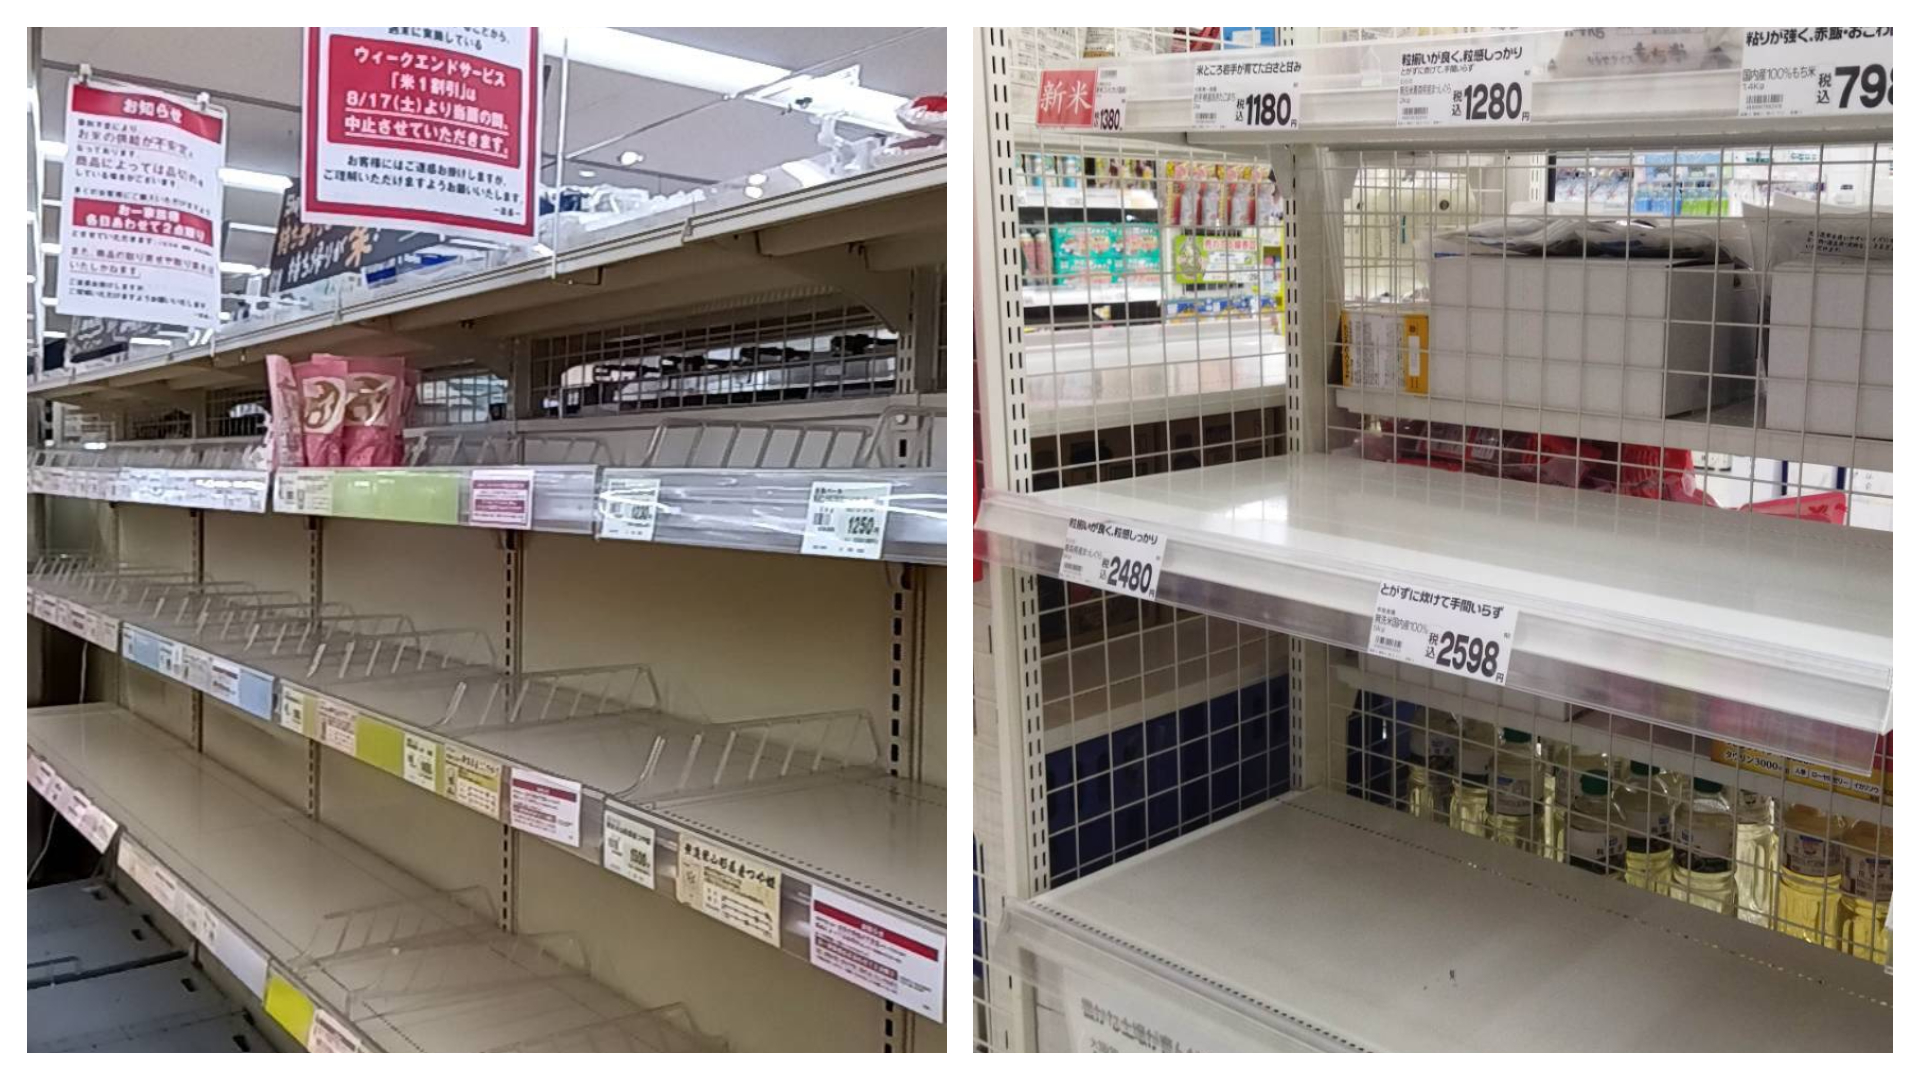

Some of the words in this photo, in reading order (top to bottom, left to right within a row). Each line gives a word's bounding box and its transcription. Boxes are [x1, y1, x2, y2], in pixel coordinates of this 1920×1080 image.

[354, 46, 506, 88] ウィークエンドサービス
[1742, 66, 1817, 82] 国内産100%もち米
[1040, 80, 1092, 115] 新米
[1451, 90, 1462, 117] 税込
[1463, 82, 1523, 121] 1280
[1521, 111, 1531, 122] 円
[1816, 72, 1832, 104] 税込
[1834, 63, 1893, 109] 79
[123, 98, 183, 124] お知らせ
[1100, 108, 1121, 131] 1380
[1235, 98, 1245, 122] 税込
[1246, 92, 1292, 127] 1180
[1106, 555, 1153, 594] 2480
[1380, 583, 1504, 619] とがずに炊けて手間いらず
[1425, 632, 1439, 660] 税込
[1435, 630, 1501, 678] 2598
[1495, 672, 1505, 683] 円
